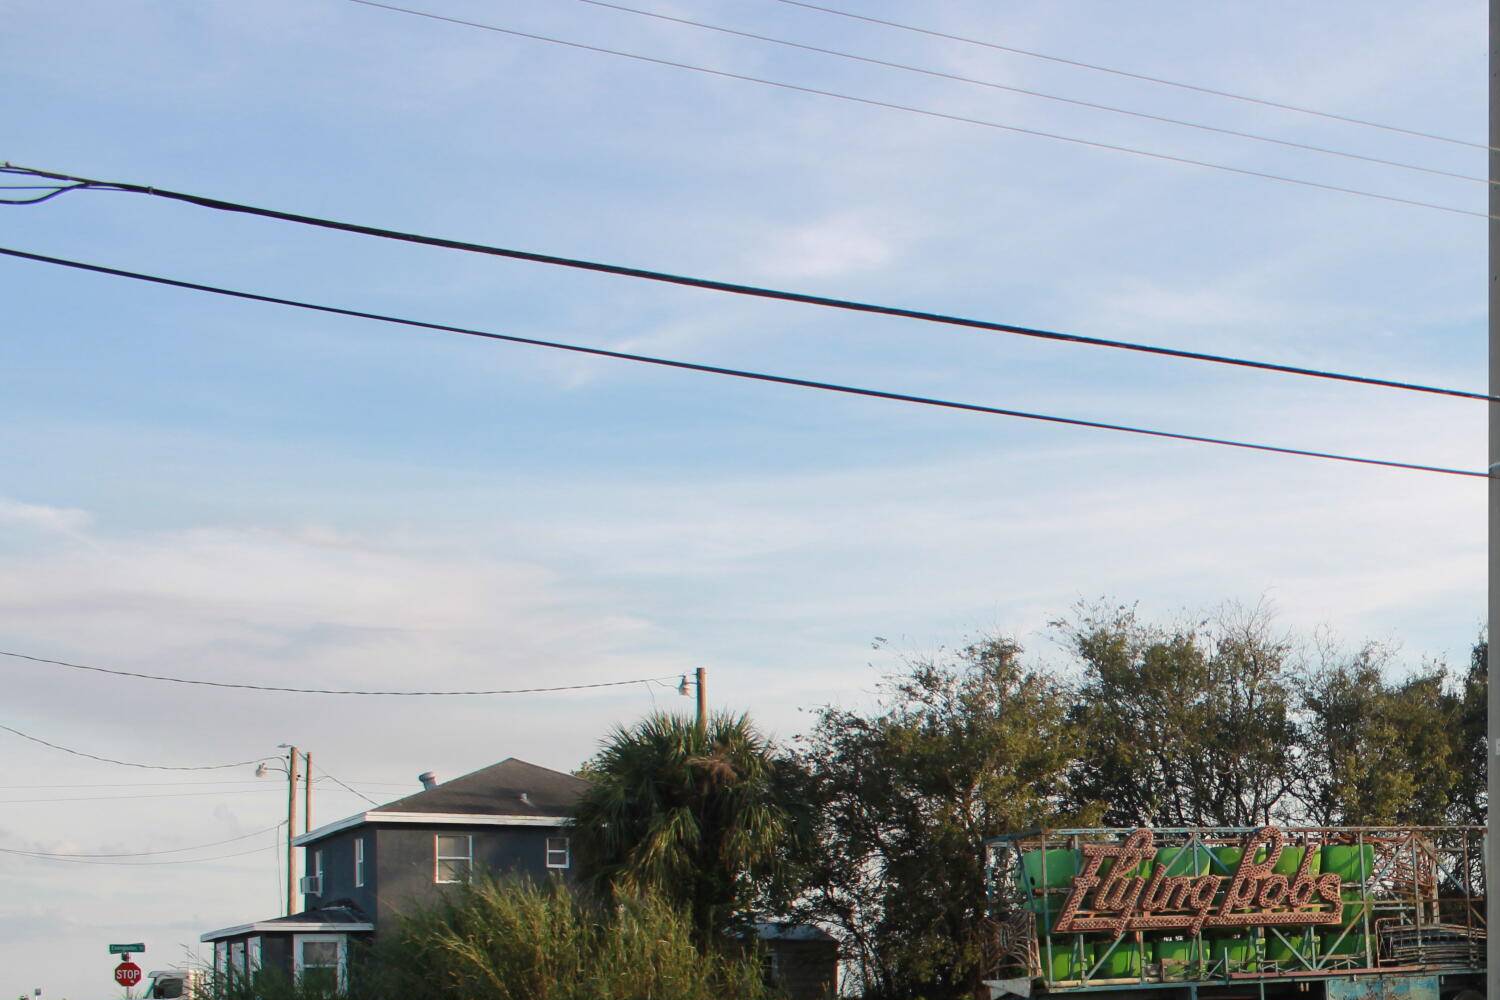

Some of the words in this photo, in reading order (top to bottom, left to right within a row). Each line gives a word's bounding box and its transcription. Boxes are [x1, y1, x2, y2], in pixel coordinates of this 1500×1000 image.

[1054, 829, 1222, 938] Flying
[1217, 826, 1343, 923] Bobs
[116, 970, 140, 980] STOP
